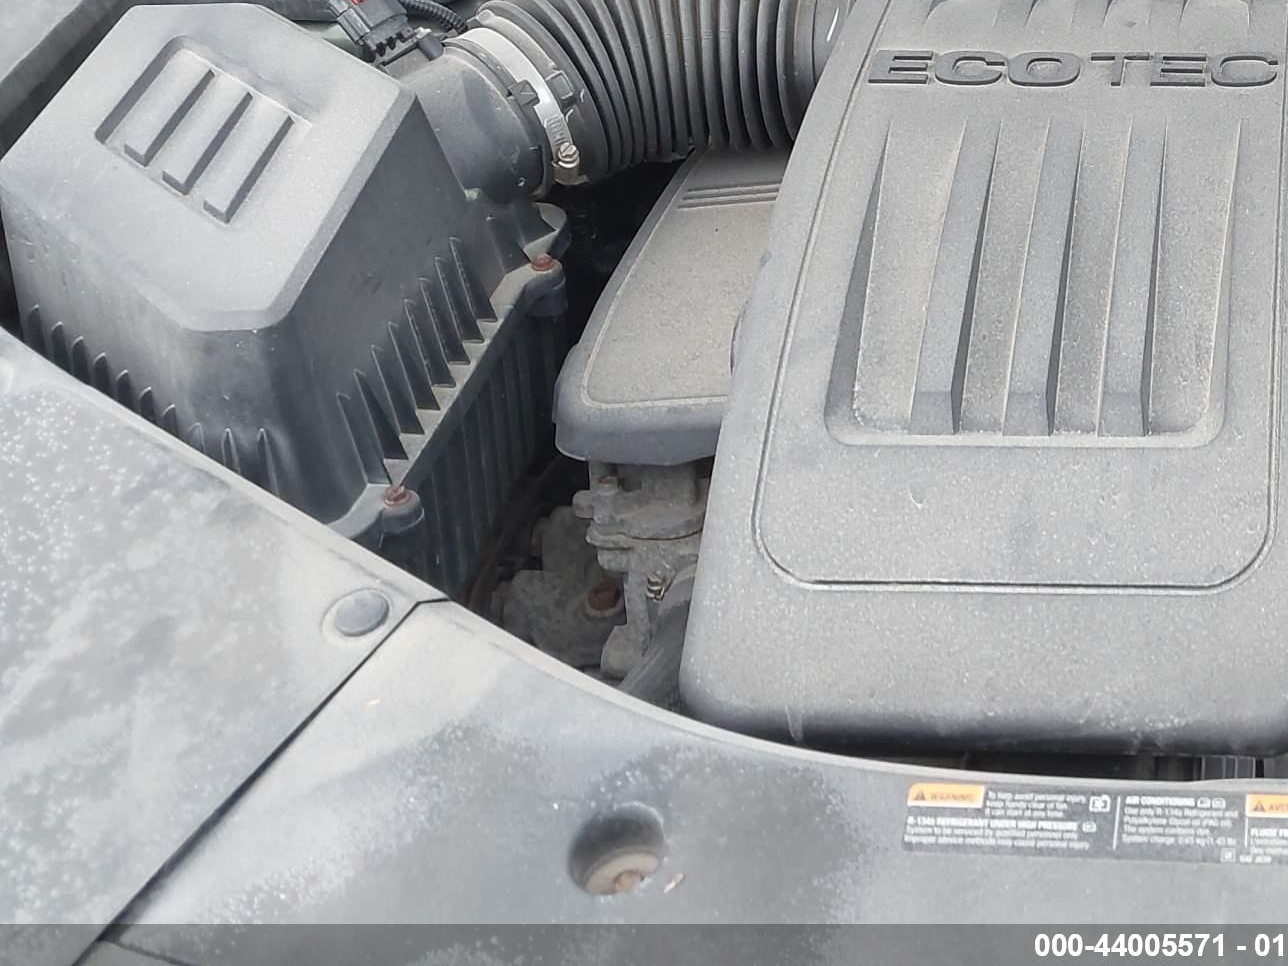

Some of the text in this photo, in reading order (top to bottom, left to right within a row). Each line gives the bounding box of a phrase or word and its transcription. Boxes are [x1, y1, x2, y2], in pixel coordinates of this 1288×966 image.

[867, 50, 1279, 88] ECOTEC
[1126, 796, 1195, 806] AIR CONDITIONING
